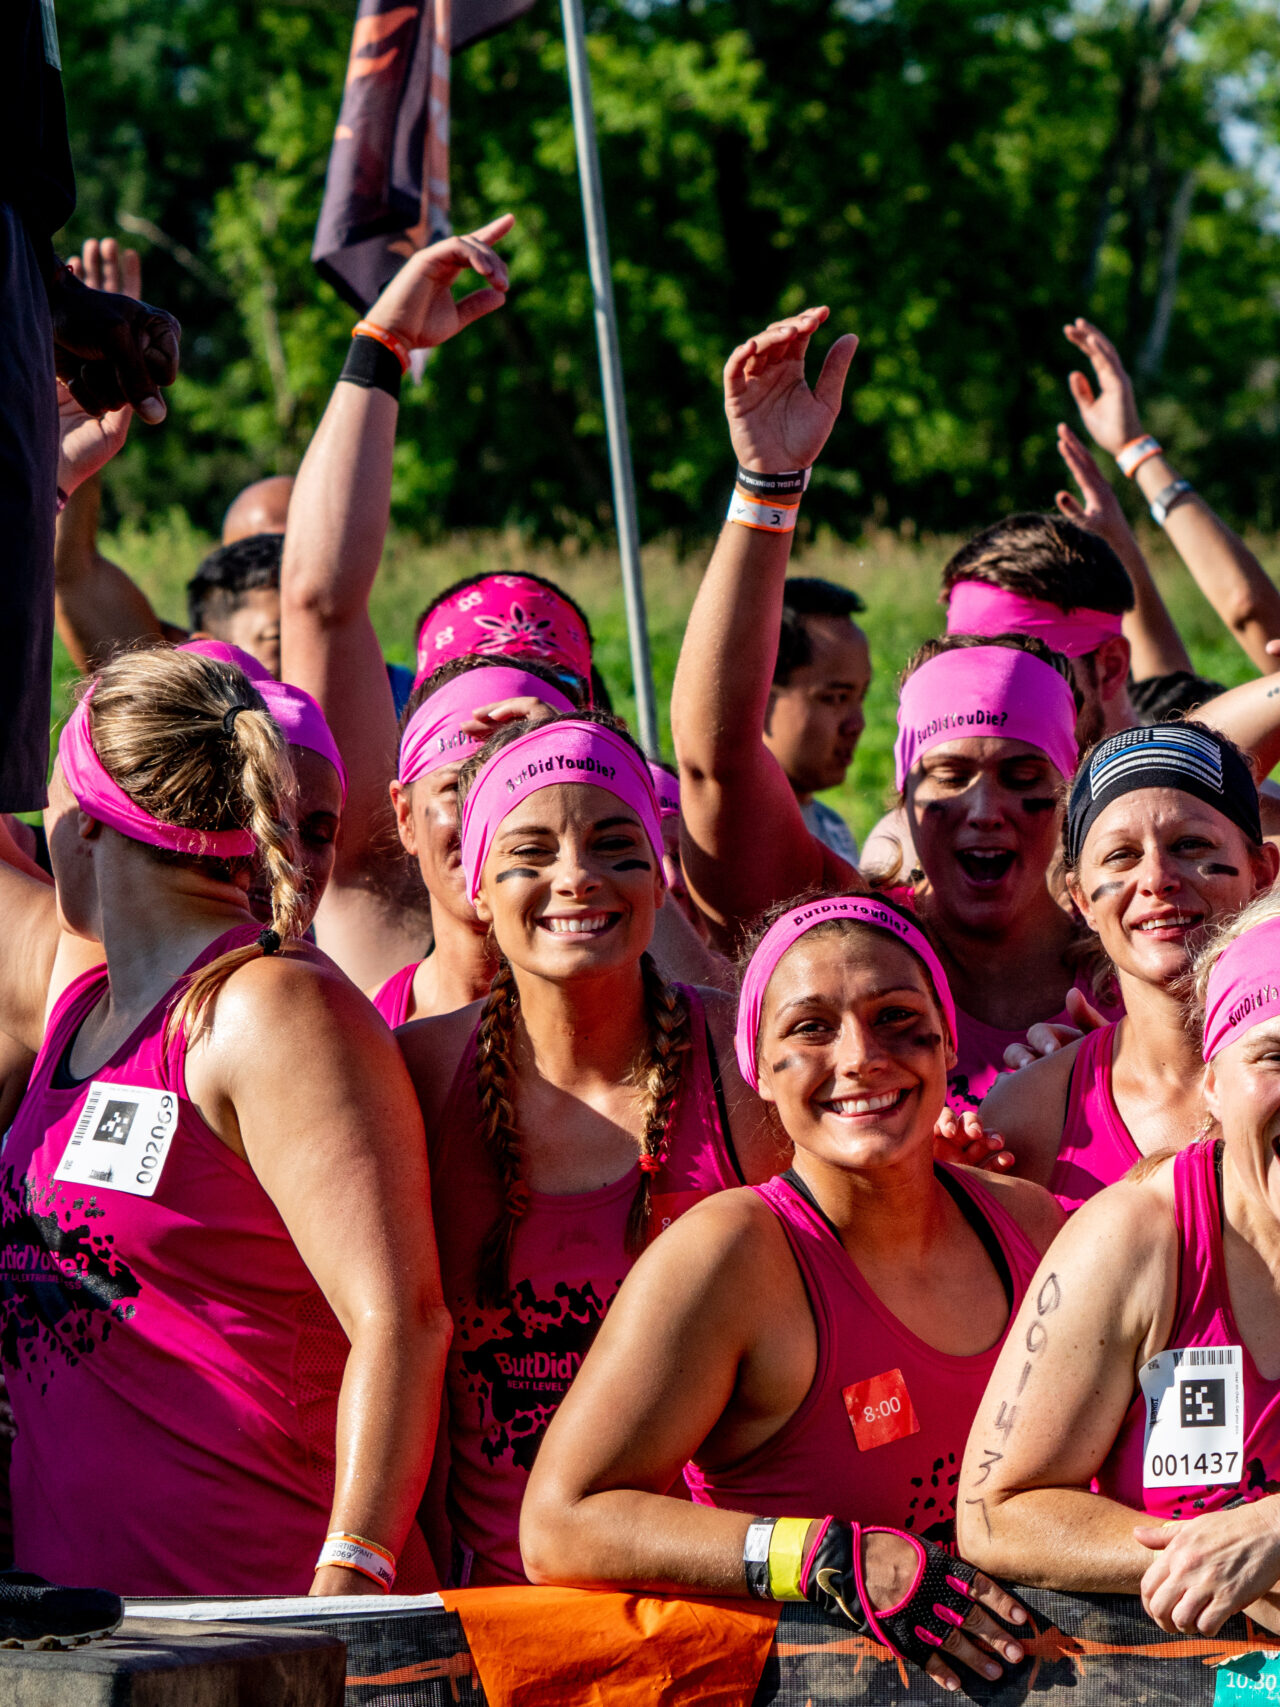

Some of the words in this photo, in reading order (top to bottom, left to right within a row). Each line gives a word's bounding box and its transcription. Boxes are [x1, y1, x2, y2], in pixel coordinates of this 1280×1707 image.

[917, 709, 1009, 745] ButDidYouDie?
[505, 754, 617, 794] ButDidYouDie?
[532, 1381, 564, 1392] LEVEL
[863, 1396, 901, 1423] 8:00
[1152, 1451, 1239, 1477] 001437
